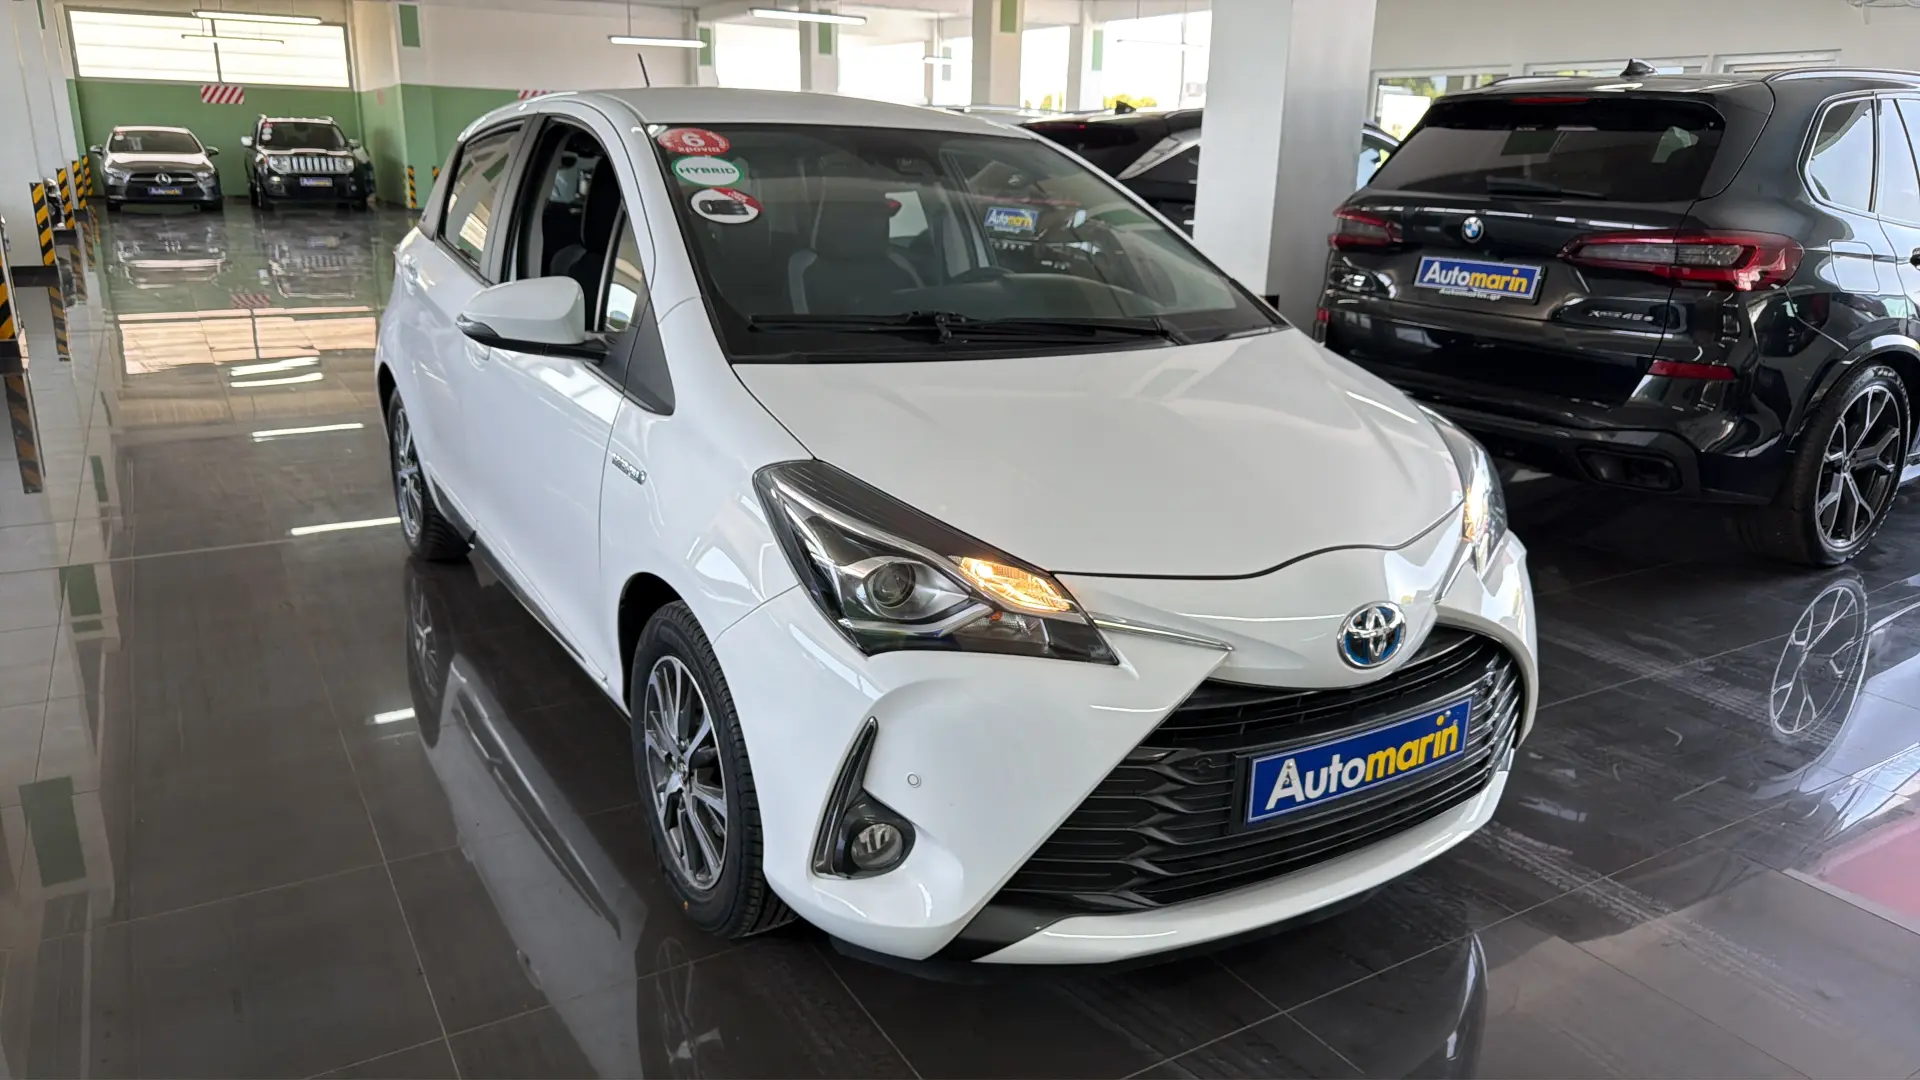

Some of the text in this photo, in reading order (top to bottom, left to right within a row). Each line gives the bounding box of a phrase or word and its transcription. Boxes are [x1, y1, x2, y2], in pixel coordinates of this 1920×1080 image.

[682, 133, 705, 147] 6
[679, 167, 737, 175] HYBRID
[1423, 261, 1528, 293] Automarin
[1265, 715, 1459, 810] Automarin
